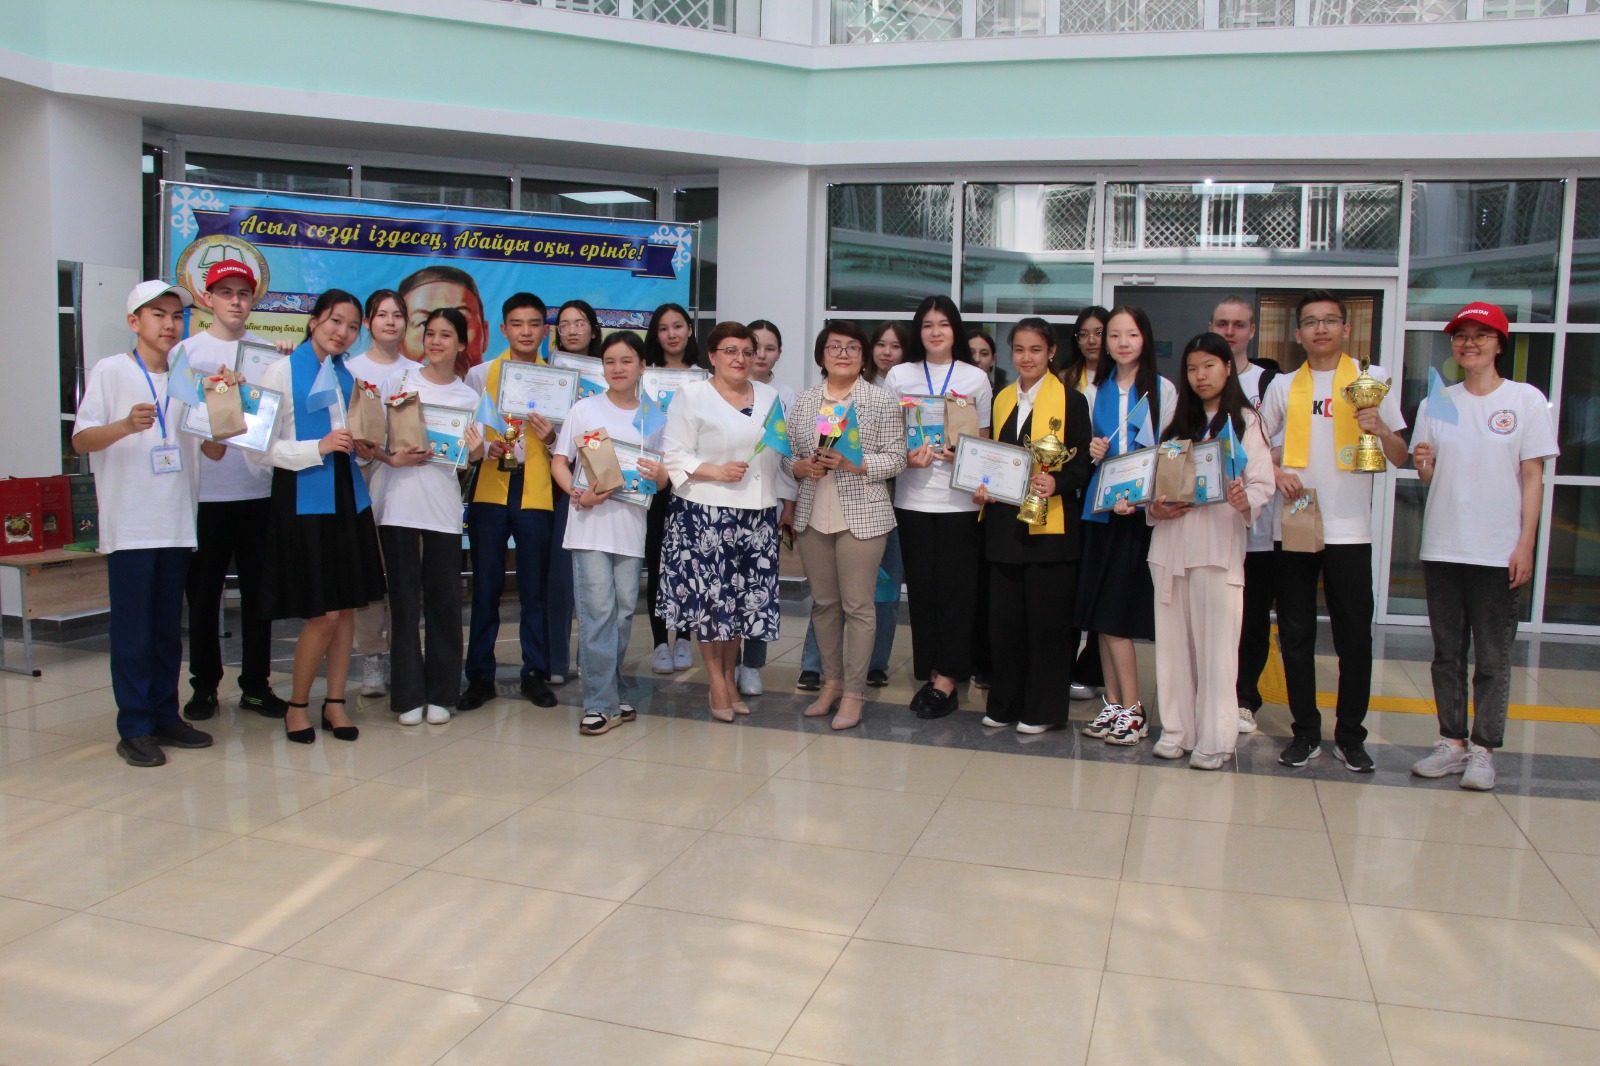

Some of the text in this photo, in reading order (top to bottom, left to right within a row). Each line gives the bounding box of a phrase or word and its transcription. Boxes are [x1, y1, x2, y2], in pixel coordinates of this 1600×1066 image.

[239, 215, 645, 262] Асыл сөзді іздесең, Абайды оқы, ерінбе!
